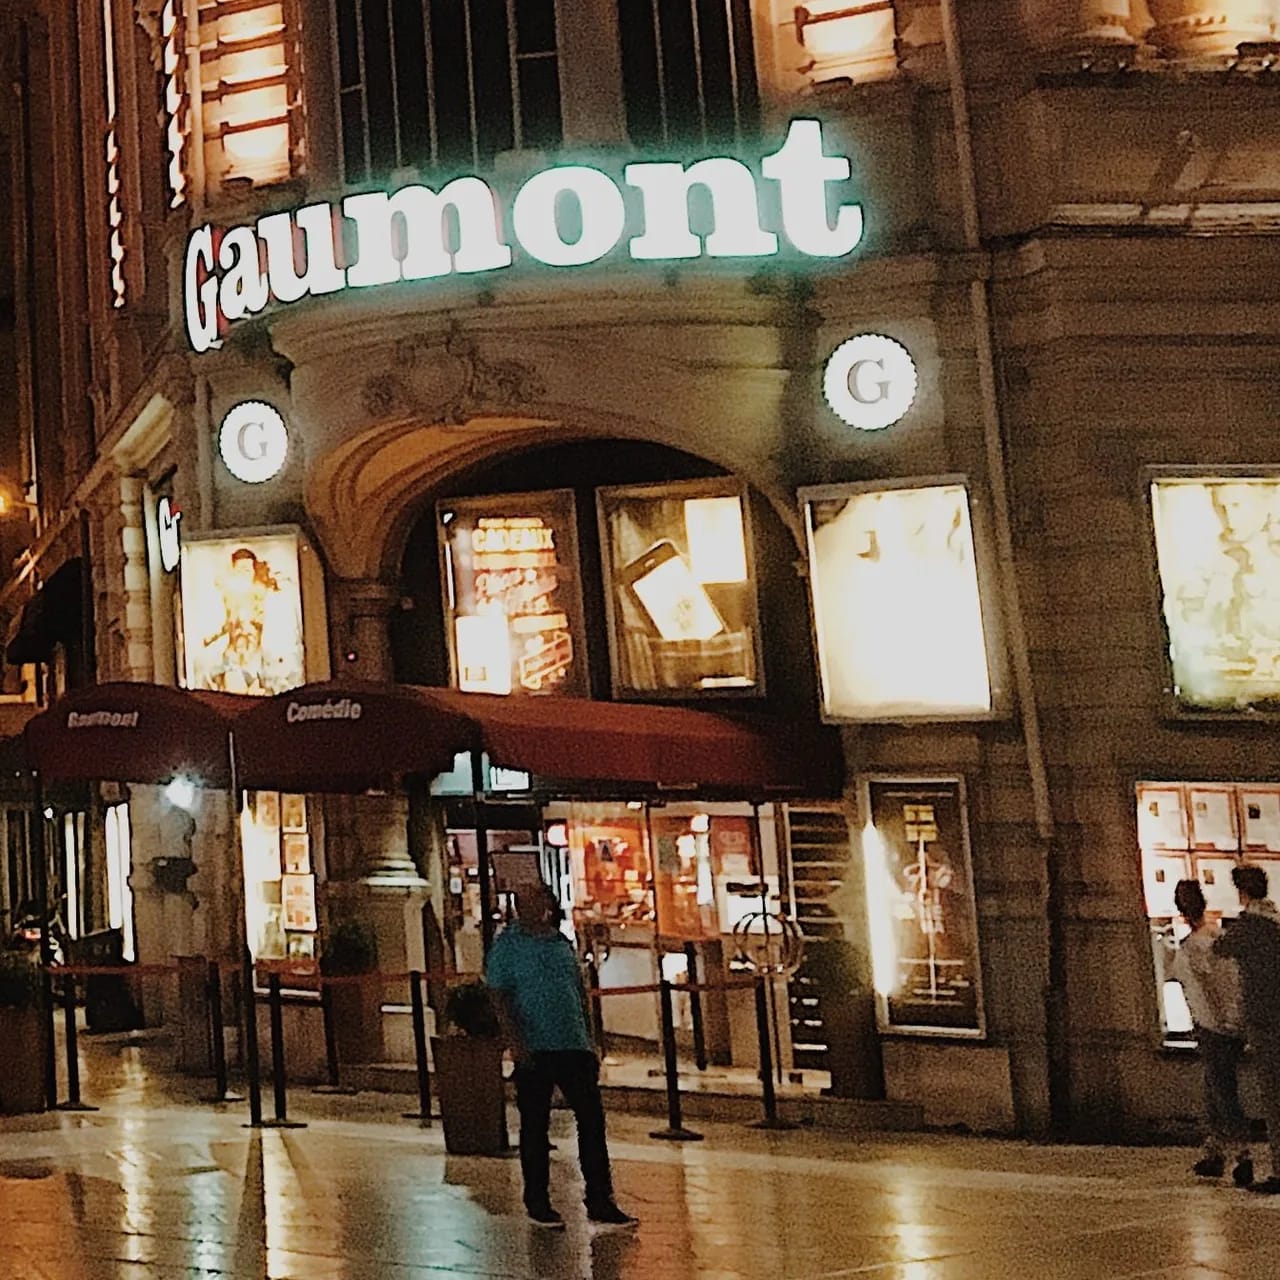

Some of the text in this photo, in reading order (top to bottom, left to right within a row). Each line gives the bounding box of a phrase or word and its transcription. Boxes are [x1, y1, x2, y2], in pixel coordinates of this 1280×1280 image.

[183, 119, 865, 353] Gaumont
[846, 358, 891, 405] G
[237, 422, 268, 461] G
[472, 528, 555, 552] CADEAUX
